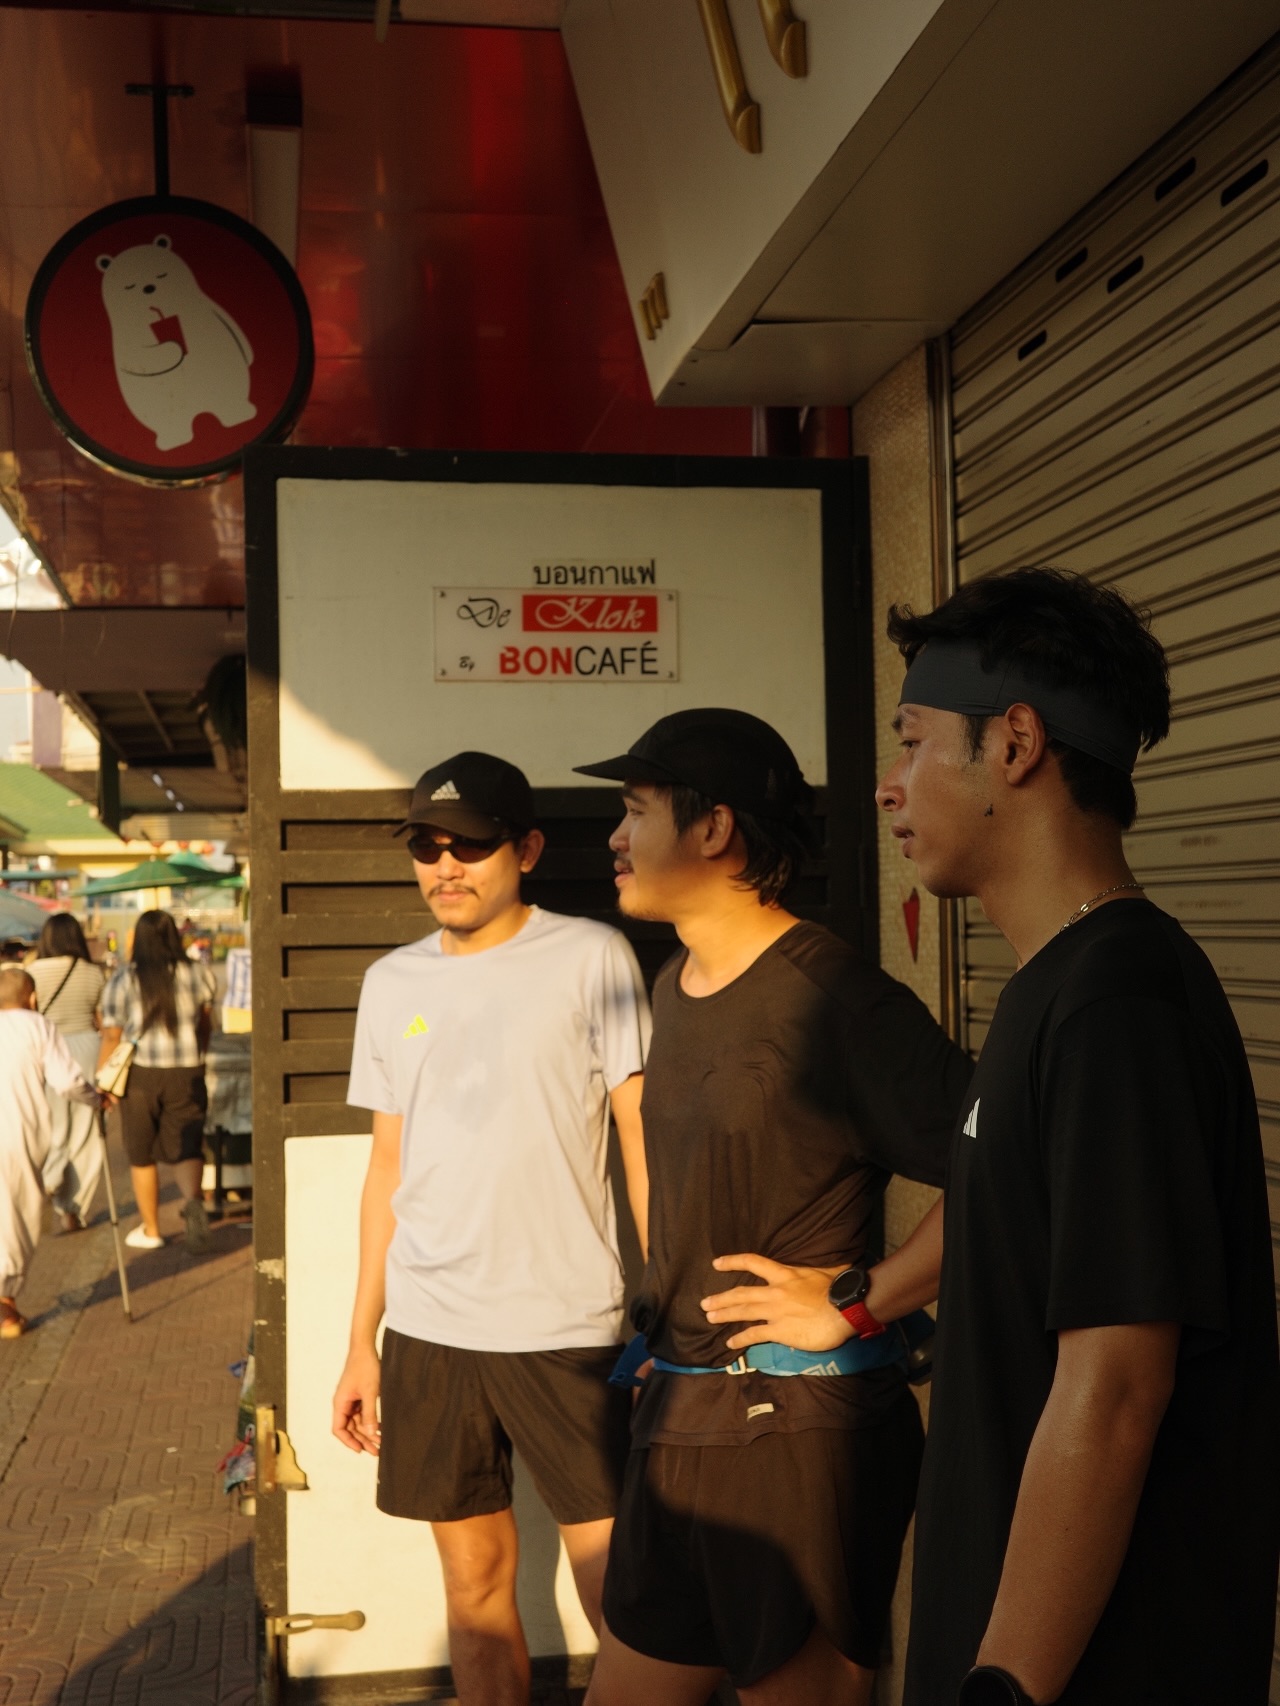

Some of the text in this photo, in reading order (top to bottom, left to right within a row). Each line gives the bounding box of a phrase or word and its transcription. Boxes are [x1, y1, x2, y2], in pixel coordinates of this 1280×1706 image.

[533, 559, 656, 585] บอนกาแฟ
[456, 597, 645, 629] De Klok
[500, 641, 658, 675] BONCAFÉ
